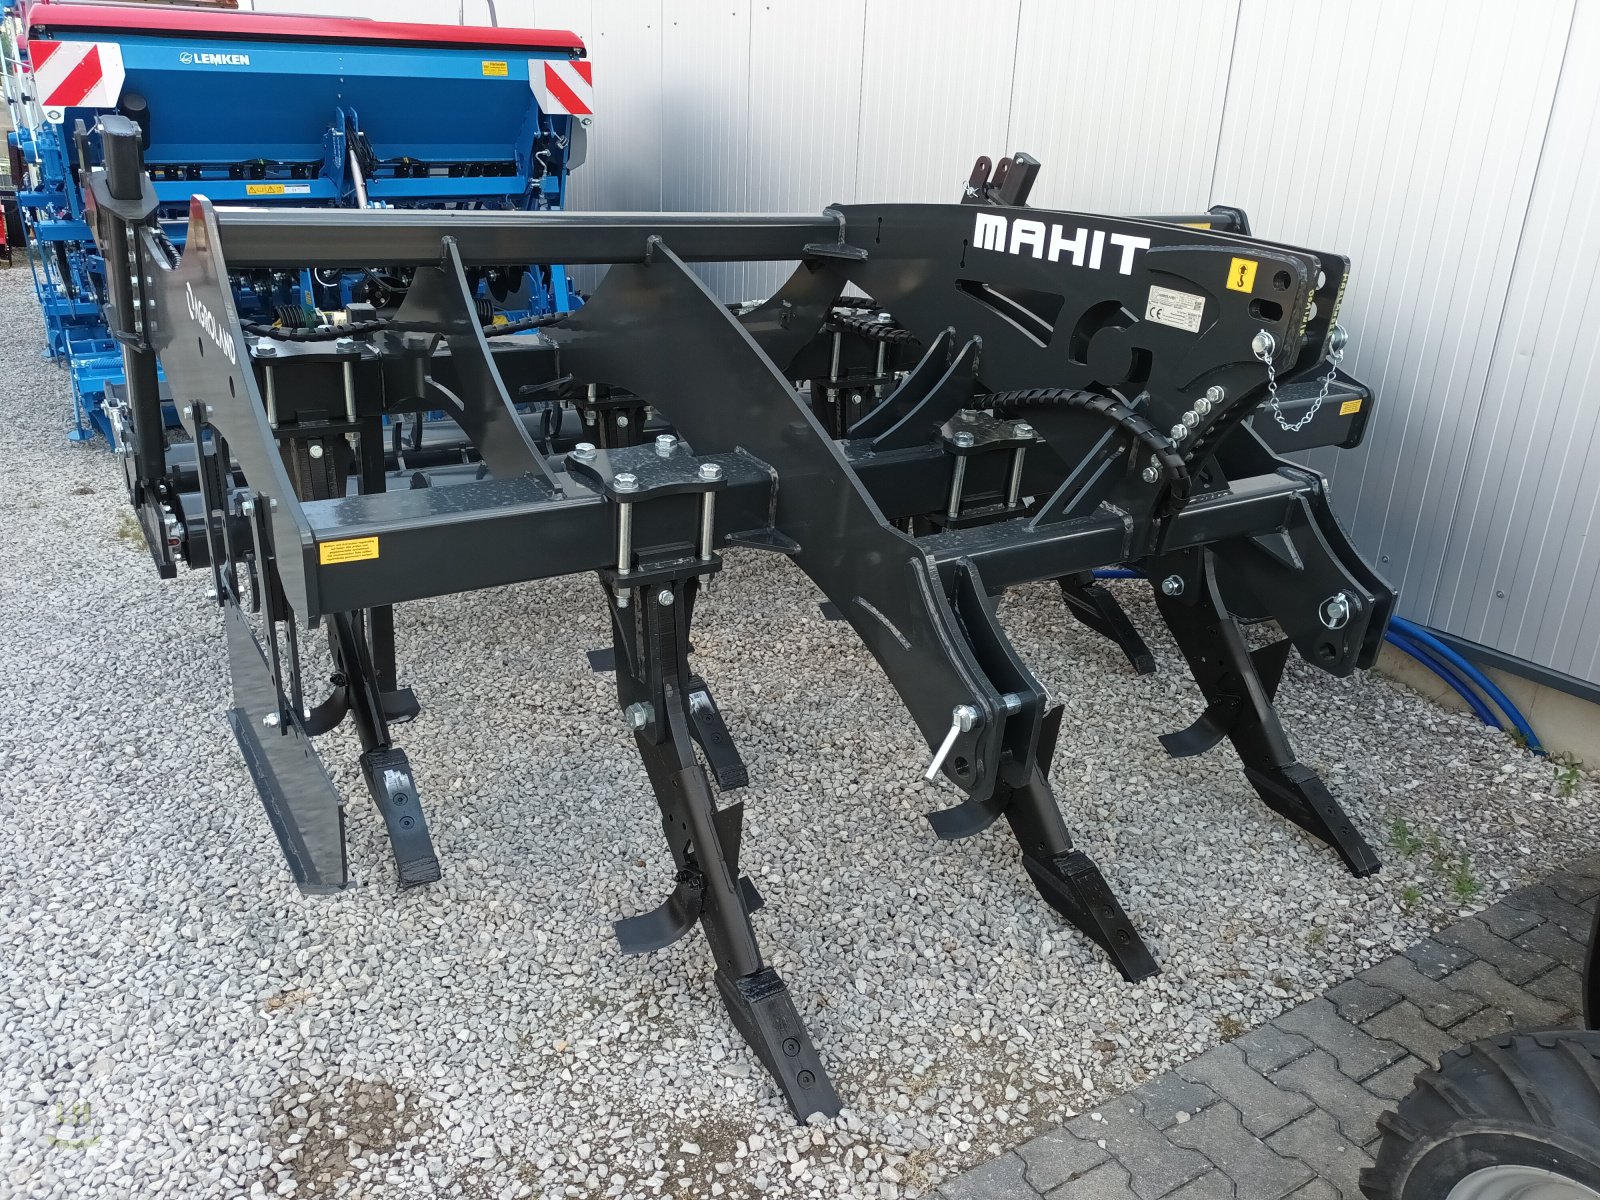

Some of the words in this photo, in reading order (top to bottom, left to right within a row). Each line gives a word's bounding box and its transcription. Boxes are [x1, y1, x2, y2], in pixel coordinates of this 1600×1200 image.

[193, 53, 250, 66] LEMKEN
[973, 212, 1151, 276] MAHIT
[195, 295, 236, 365] AGROLAND
